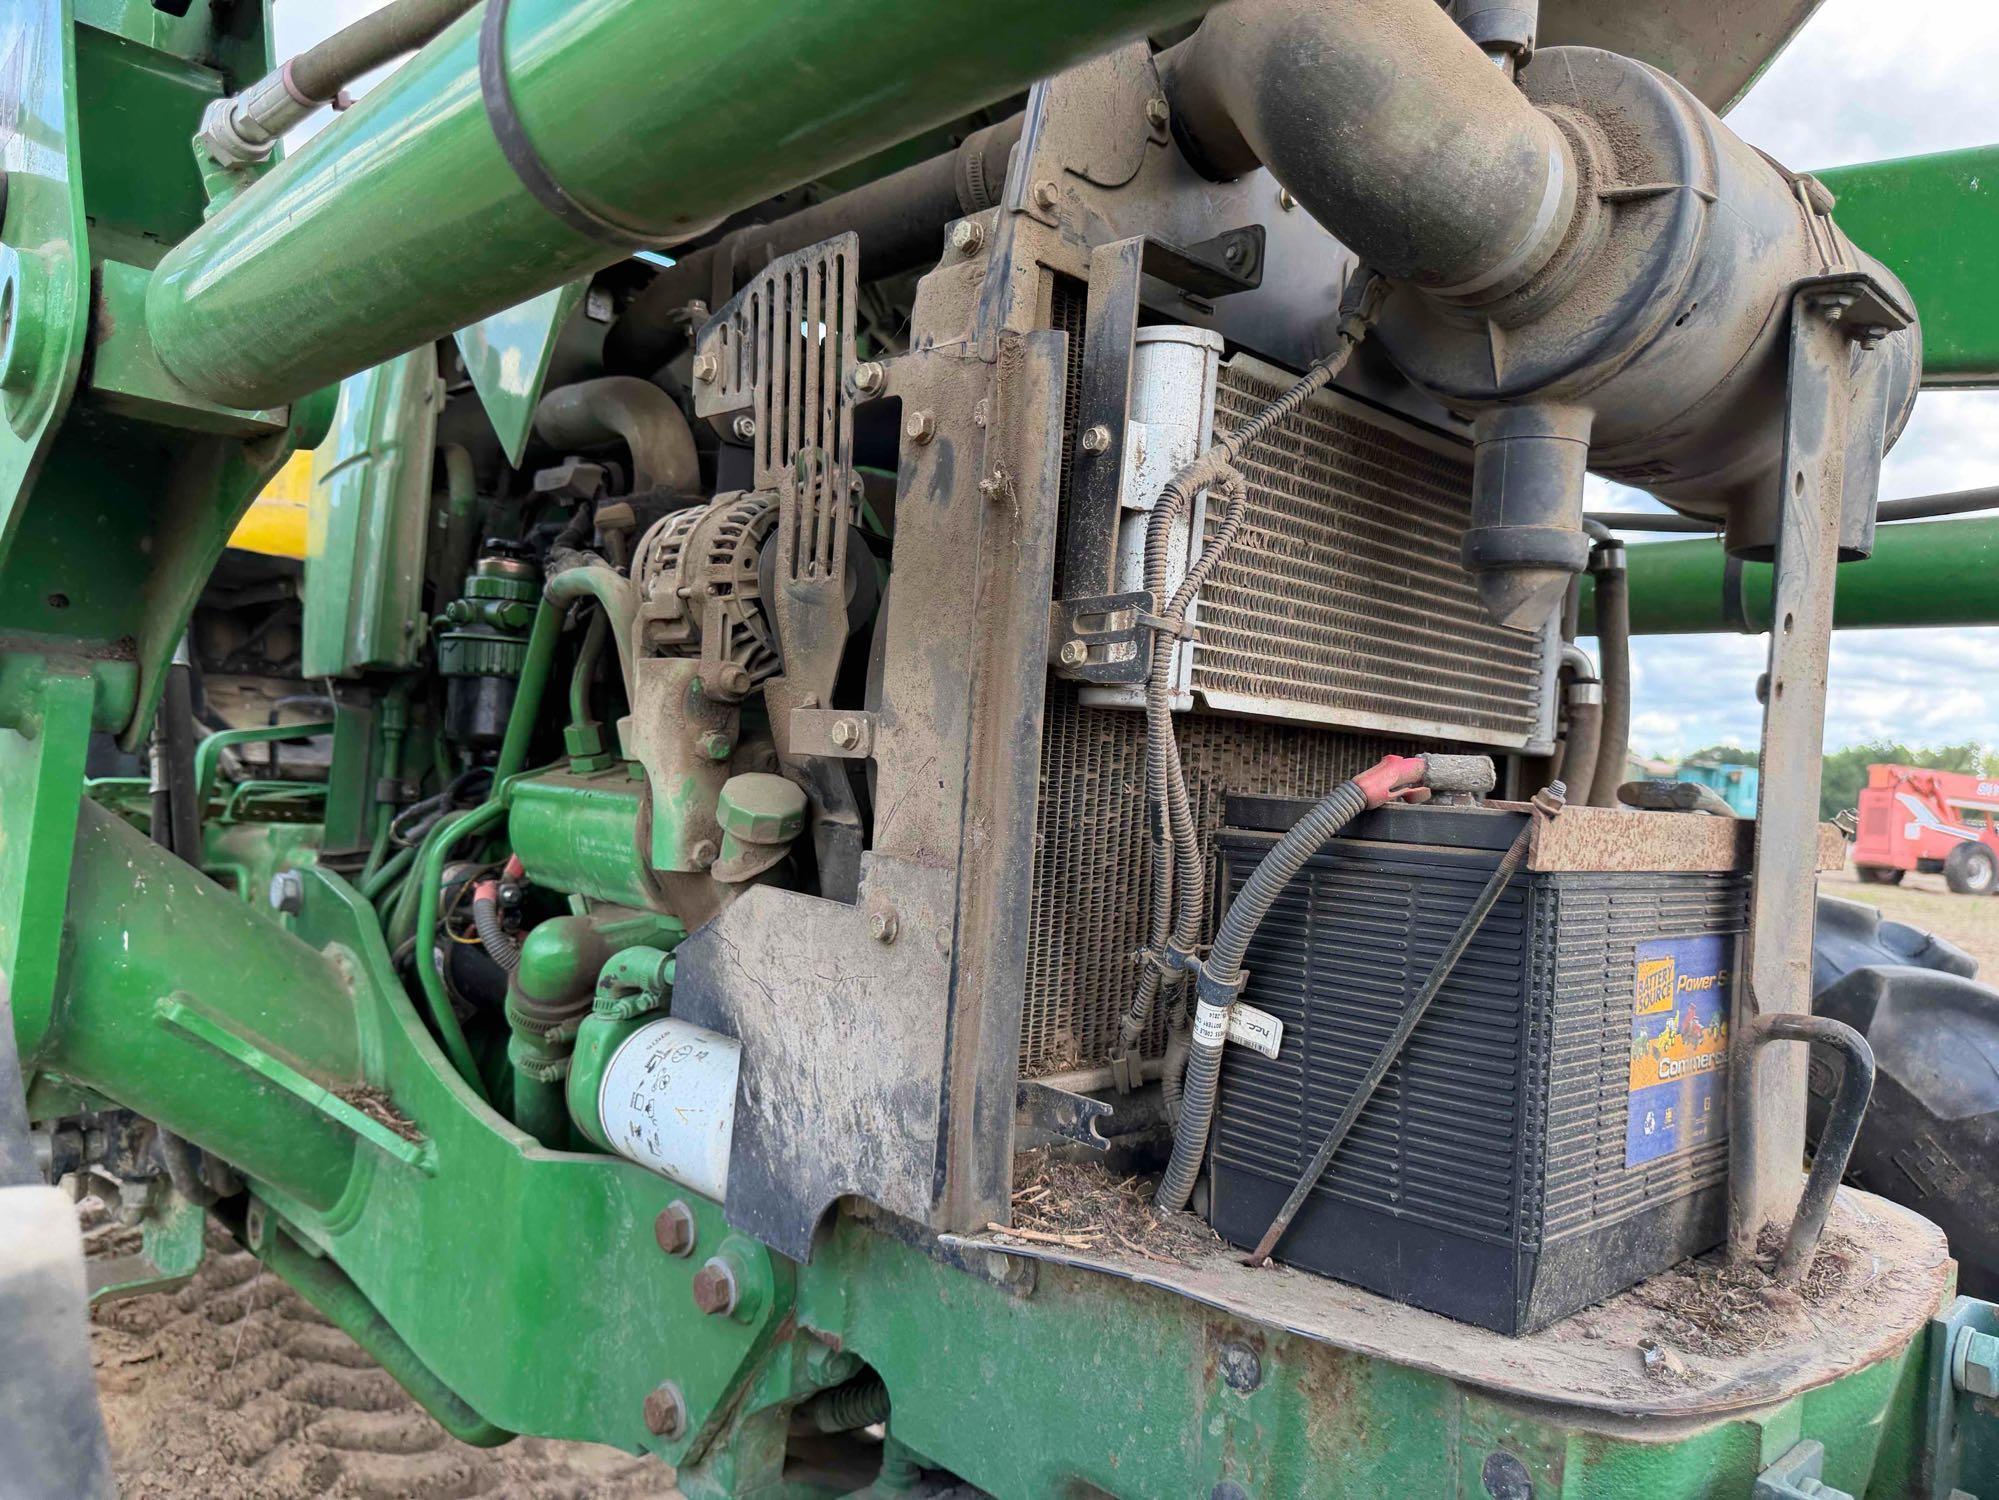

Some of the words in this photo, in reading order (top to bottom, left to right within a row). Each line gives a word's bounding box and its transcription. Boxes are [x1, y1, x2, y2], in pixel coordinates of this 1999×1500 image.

[1637, 965, 1673, 995] BATTERY
[1677, 974, 1717, 993] Power
[1637, 983, 1672, 1013] SOURCE
